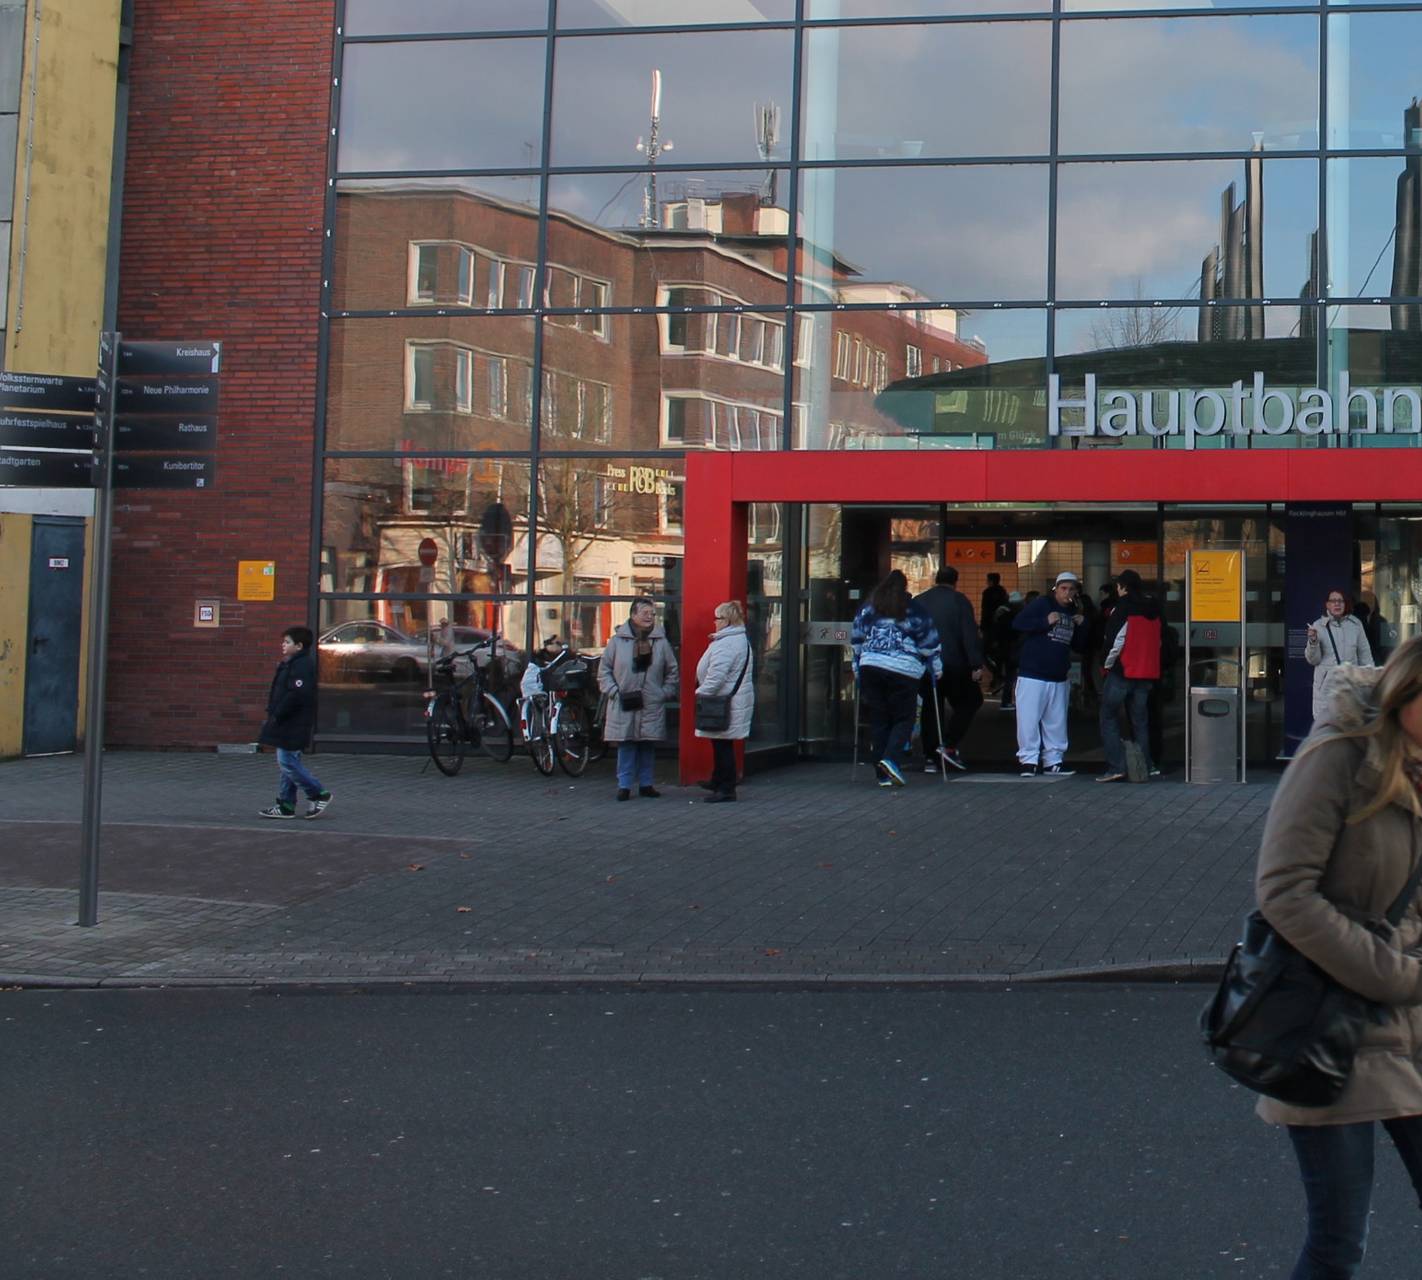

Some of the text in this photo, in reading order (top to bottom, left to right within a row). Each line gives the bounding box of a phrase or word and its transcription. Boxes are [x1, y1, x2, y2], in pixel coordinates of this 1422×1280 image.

[176, 347, 211, 357] Kreishaus
[143, 385, 162, 395] Neue
[163, 385, 210, 395] Philharmonie
[0, 416, 67, 430] uhrfestspielhaus
[178, 423, 208, 433] Rathaus
[0, 456, 40, 468] tadtgarten
[607, 463, 626, 478] Press
